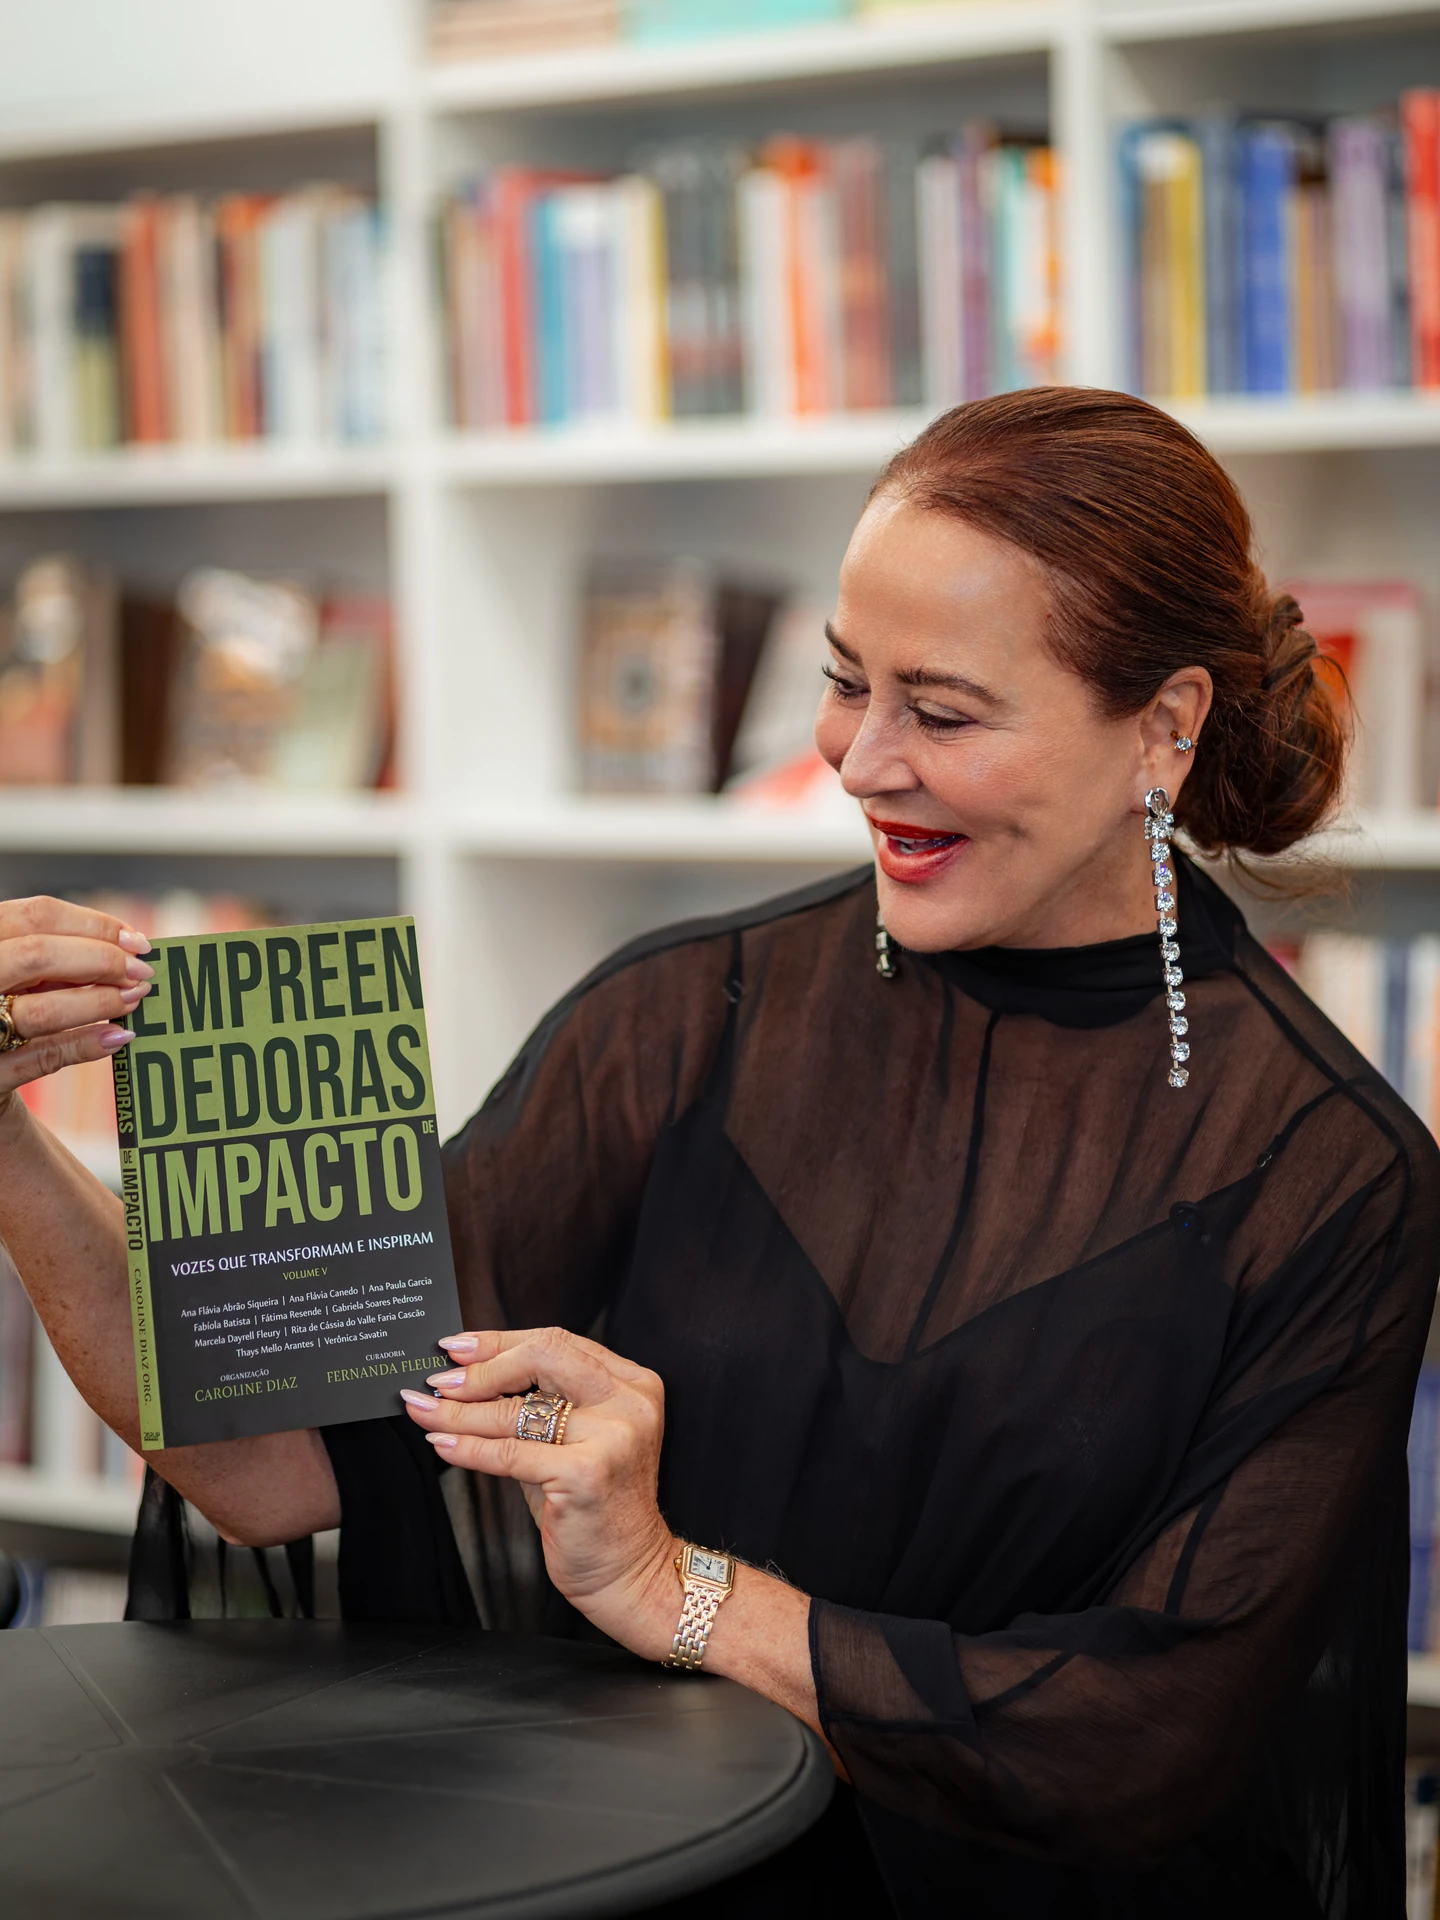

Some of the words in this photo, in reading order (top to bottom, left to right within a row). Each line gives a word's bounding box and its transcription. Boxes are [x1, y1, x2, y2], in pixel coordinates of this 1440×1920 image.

[131, 925, 424, 1038] EMPREEN
[135, 1024, 426, 1140] DEDORAS
[422, 1120, 435, 1134] DE
[123, 1150, 133, 1164] DE
[143, 1123, 423, 1243] IMPACTO
[122, 1168, 144, 1251] IMPACTO
[171, 1259, 215, 1277] VOZES
[218, 1255, 248, 1271] QUE
[249, 1241, 354, 1266] TRANSFORMAM
[357, 1240, 365, 1253] E
[368, 1231, 434, 1251] INSPIRAM
[283, 1268, 320, 1280] VOLUME
[321, 1267, 328, 1275] V
[134, 1268, 147, 1335] CAROLINE
[181, 1309, 197, 1318] Ana
[198, 1305, 221, 1315] Flávia
[222, 1302, 246, 1313] Abrão
[247, 1297, 279, 1310] Siqueira
[289, 1295, 304, 1303] Ana
[306, 1290, 328, 1301] Flávia
[329, 1286, 358, 1298] Canedo
[368, 1284, 384, 1293] Ana
[385, 1280, 407, 1291] Paula
[407, 1277, 433, 1288] Garcia
[223, 1317, 251, 1328] Batista
[261, 1312, 288, 1323] Fátima
[289, 1307, 322, 1319] Resende
[332, 1301, 364, 1313] Gabriela
[365, 1298, 391, 1309] Soares
[392, 1294, 423, 1305] Pedroso
[194, 1336, 226, 1348] Marcela
[227, 1331, 255, 1344] Dayrell
[256, 1329, 281, 1339] Fleury
[291, 1325, 307, 1334] Rita
[308, 1323, 318, 1332] de
[320, 1319, 344, 1330] Cássia
[346, 1318, 356, 1326] do
[357, 1315, 376, 1325] Valle
[377, 1313, 397, 1322] Faria
[397, 1309, 425, 1320] Cascão
[236, 1348, 260, 1358] Thays
[260, 1343, 283, 1354] Mello
[284, 1340, 314, 1351] Arantes
[323, 1333, 358, 1345] Verônica
[359, 1329, 388, 1341] Savatin
[140, 1339, 149, 1370] DIAZ
[326, 1362, 398, 1383] FERNANDA
[401, 1355, 448, 1373] FLEURY
[365, 1350, 405, 1361] CURADORIA
[142, 1373, 152, 1406] ORG.
[194, 1381, 263, 1402] CAROLINE
[266, 1376, 298, 1392] DIAZ
[220, 1368, 270, 1382] ORGANIZAÇÃO
